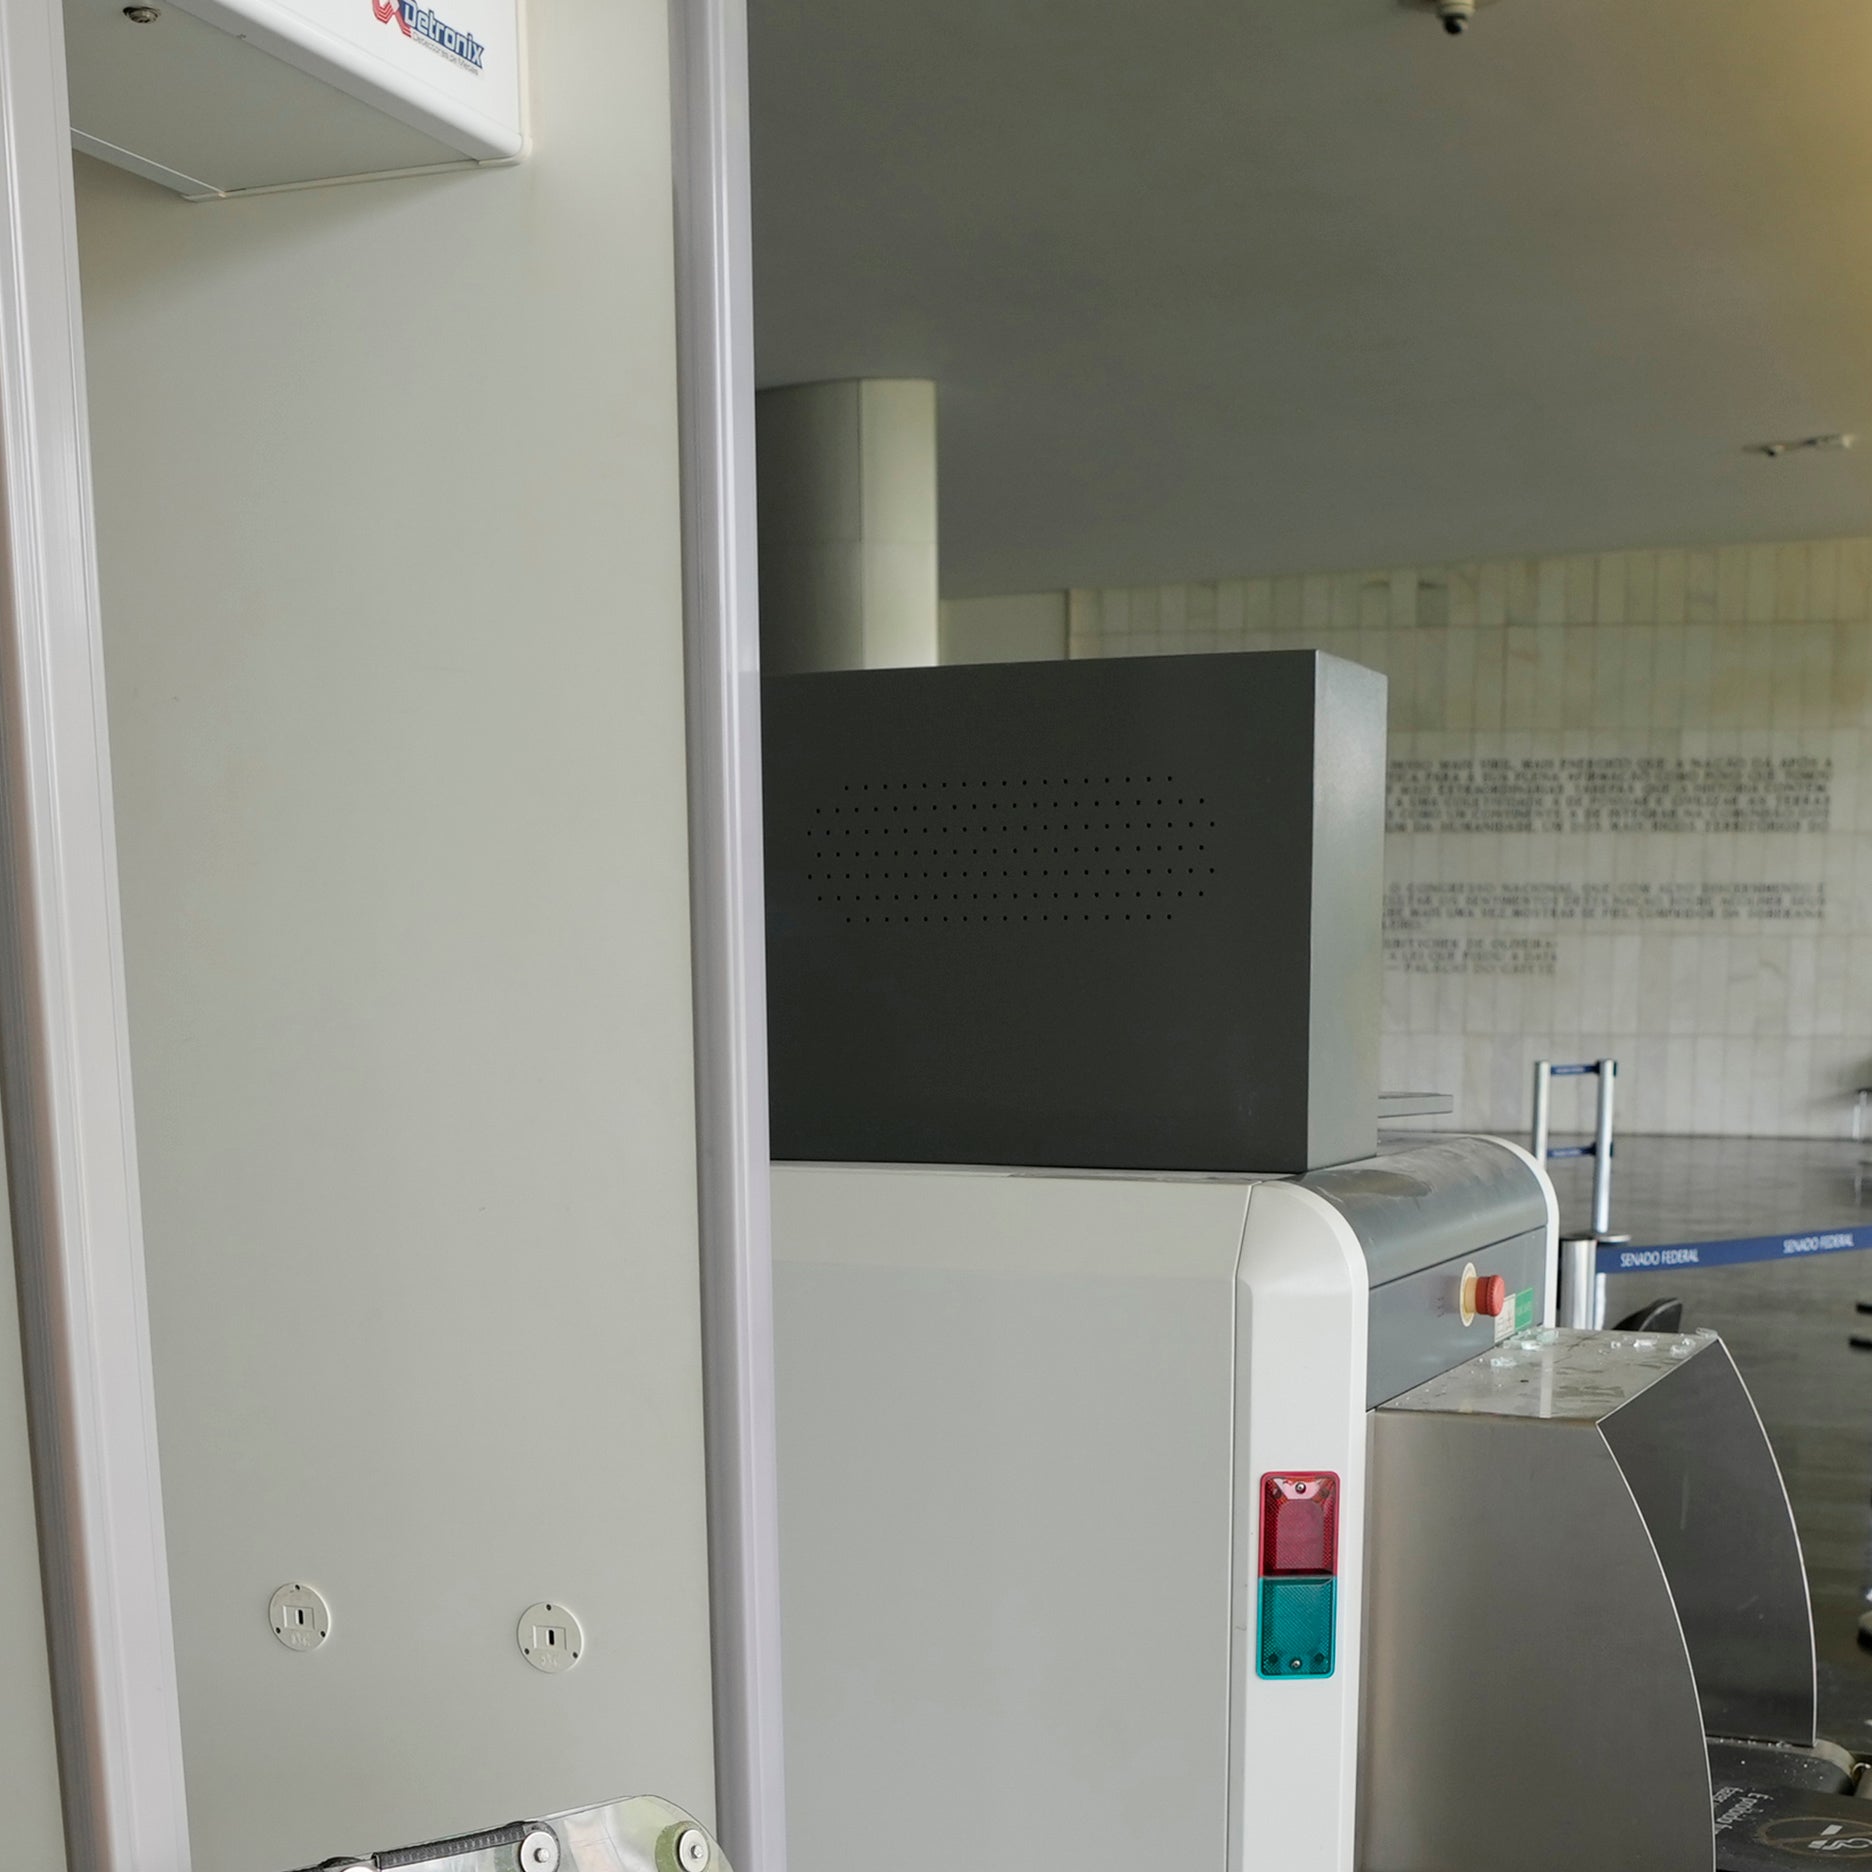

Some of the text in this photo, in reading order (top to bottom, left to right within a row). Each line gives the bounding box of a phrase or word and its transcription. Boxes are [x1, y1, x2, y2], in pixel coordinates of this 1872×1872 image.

[401, 0, 484, 69] Detronix
[1783, 1233, 1854, 1254] SENADO FEDERAL
[1620, 1248, 1699, 1267] SENADO FEDERAL
[1716, 1797, 1764, 1824] proibido
